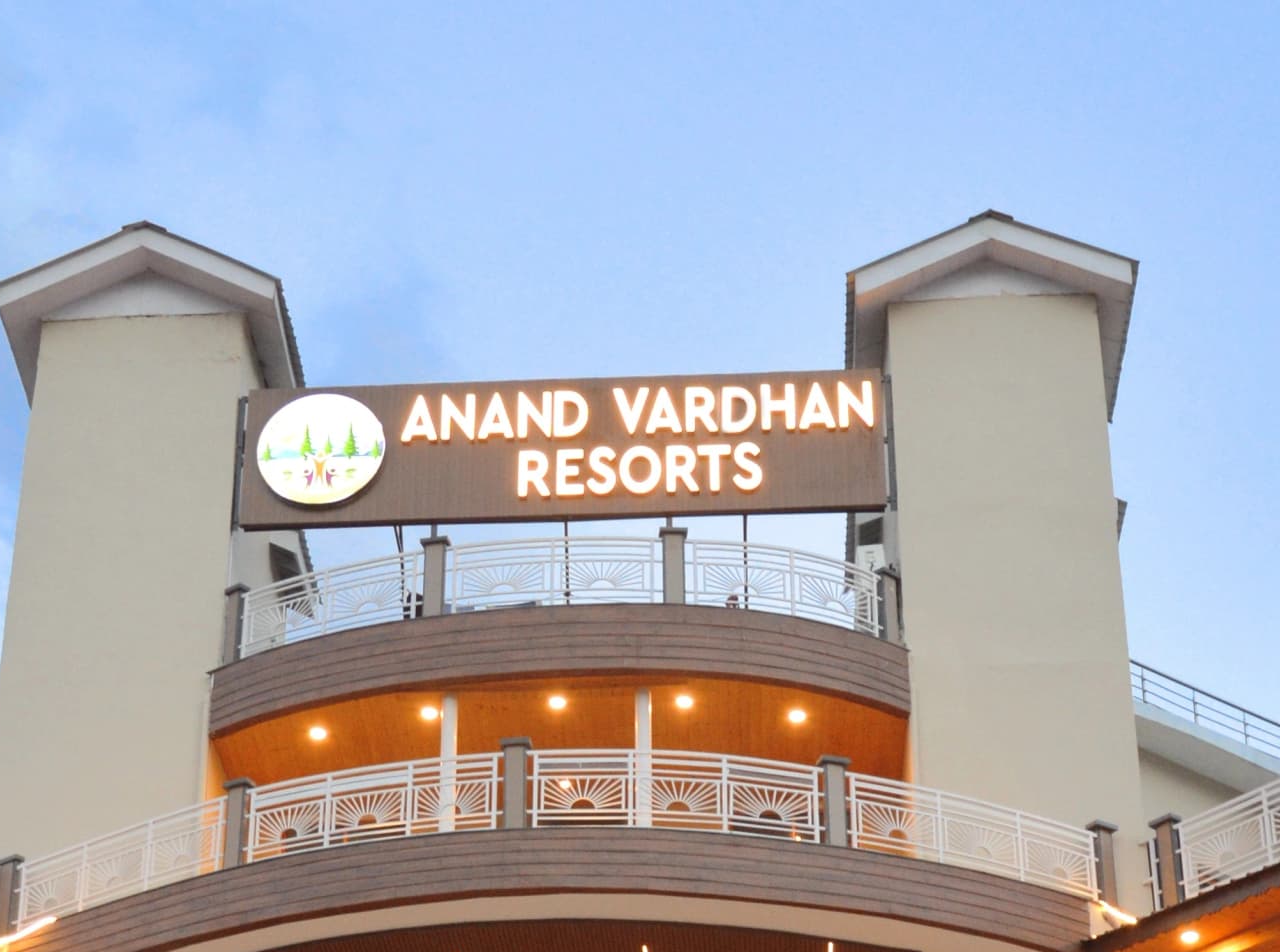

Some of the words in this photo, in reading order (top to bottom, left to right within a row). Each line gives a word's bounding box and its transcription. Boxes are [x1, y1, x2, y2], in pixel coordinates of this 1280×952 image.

[400, 390, 589, 442] ANAND
[612, 380, 874, 434] VARDHAN
[516, 442, 763, 497] RESORTS
